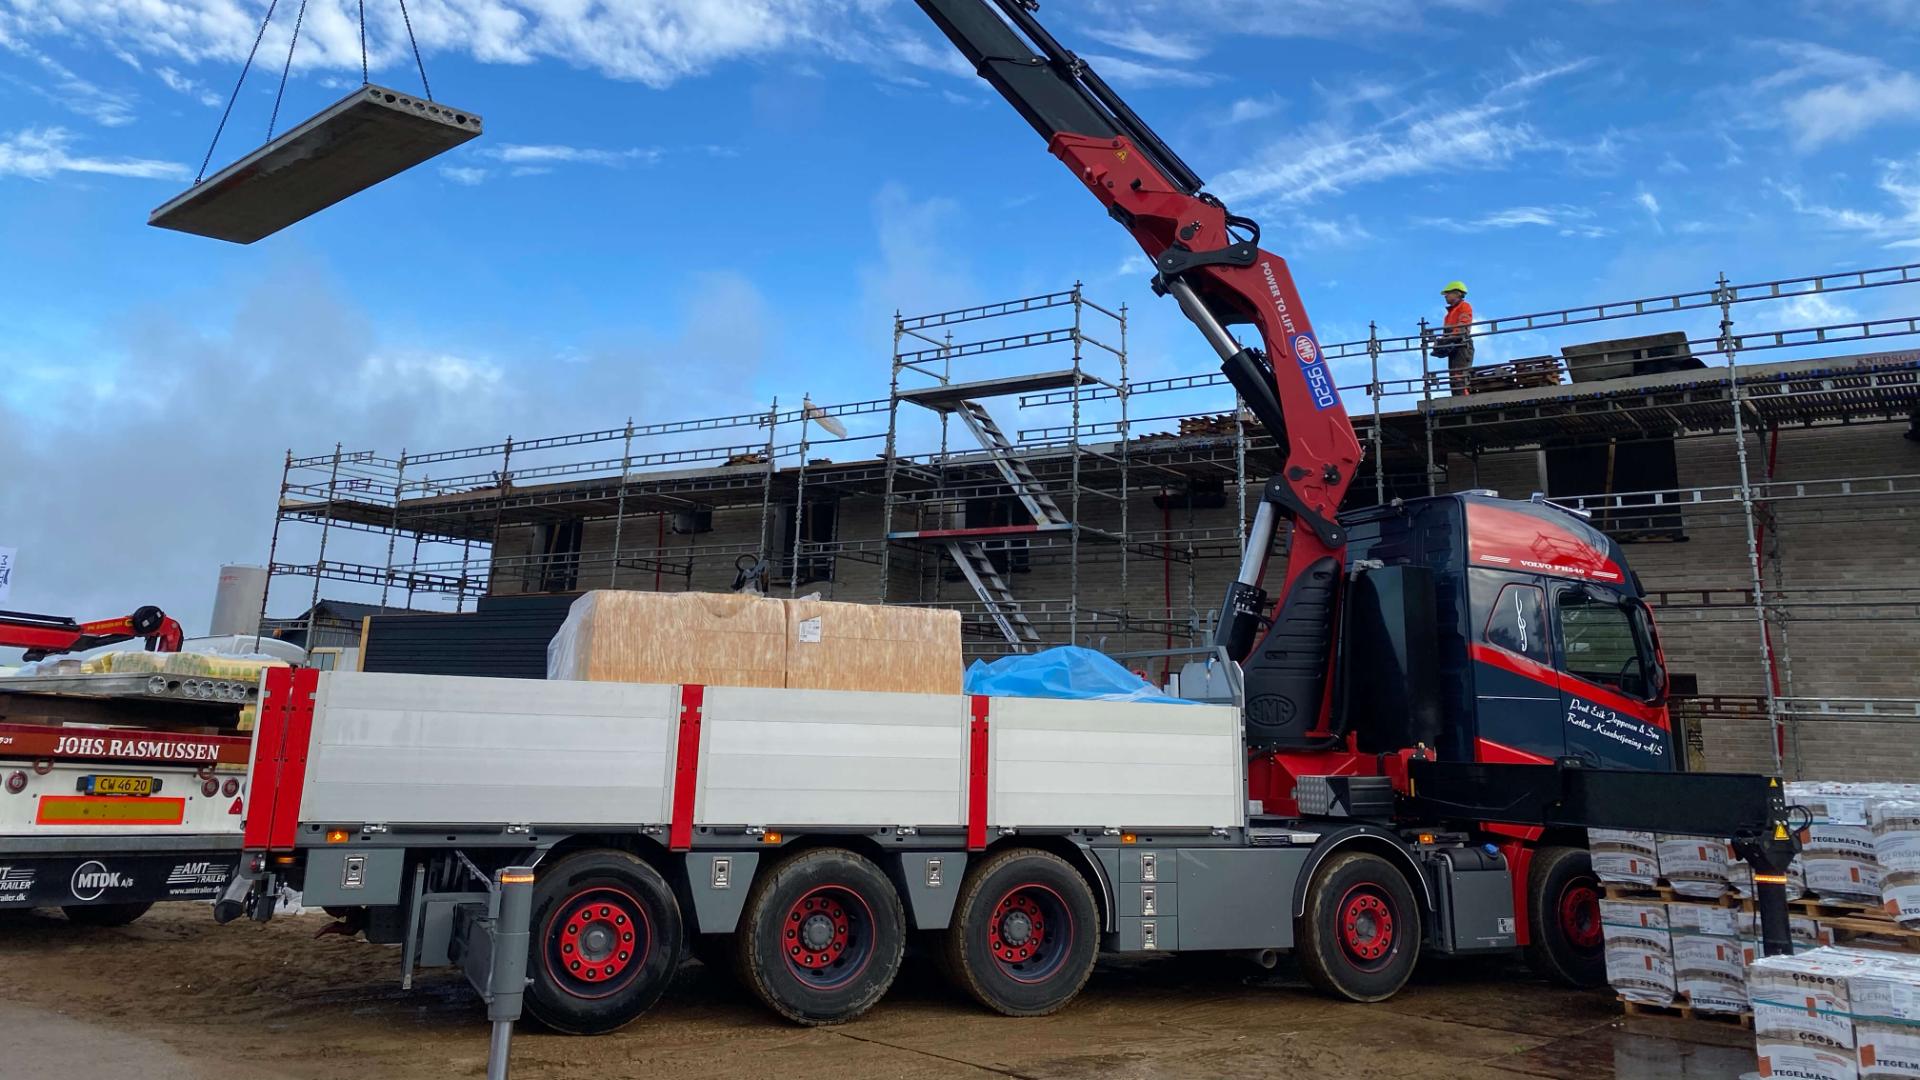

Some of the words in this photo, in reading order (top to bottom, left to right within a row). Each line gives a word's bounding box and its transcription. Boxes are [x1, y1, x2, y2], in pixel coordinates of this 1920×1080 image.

[1261, 262, 1281, 297] POWER
[1275, 298, 1287, 312] TO
[1281, 313, 1296, 333] LIFT
[1297, 338, 1315, 360] HMF
[1307, 366, 1334, 407] 9520
[1520, 560, 1552, 570] VOLVO
[1590, 705, 1606, 720] Erik
[1638, 724, 1645, 734] &
[54, 736, 107, 756] JOHS.
[108, 739, 220, 761] RASMUSSEN
[1643, 743, 1663, 756] A/S
[100, 778, 117, 791] CW
[117, 779, 131, 791] 46
[133, 779, 147, 792] 20
[181, 862, 211, 875] AMT
[78, 872, 121, 888] MTDK
[120, 877, 134, 888] A/S
